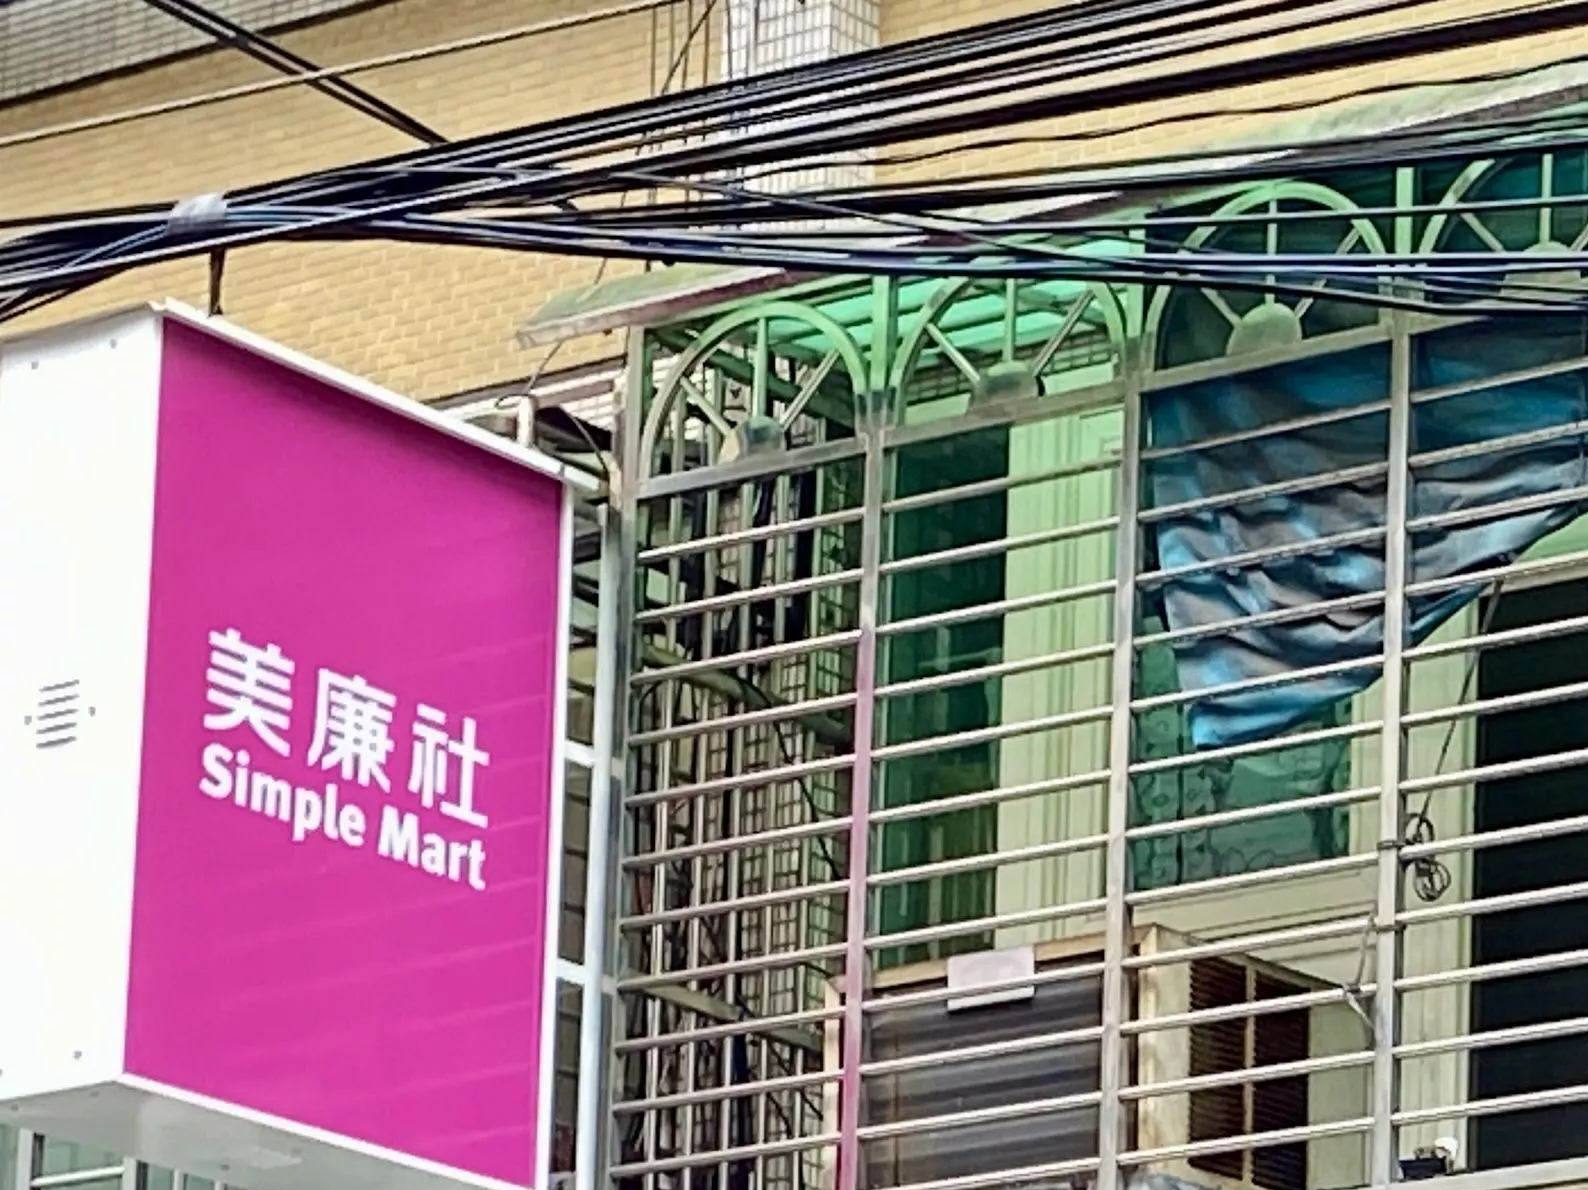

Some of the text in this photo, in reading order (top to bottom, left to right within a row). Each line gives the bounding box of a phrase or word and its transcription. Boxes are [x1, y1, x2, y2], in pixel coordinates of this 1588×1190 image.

[202, 627, 491, 830] 美廉社
[198, 742, 488, 892] Simple Mart
